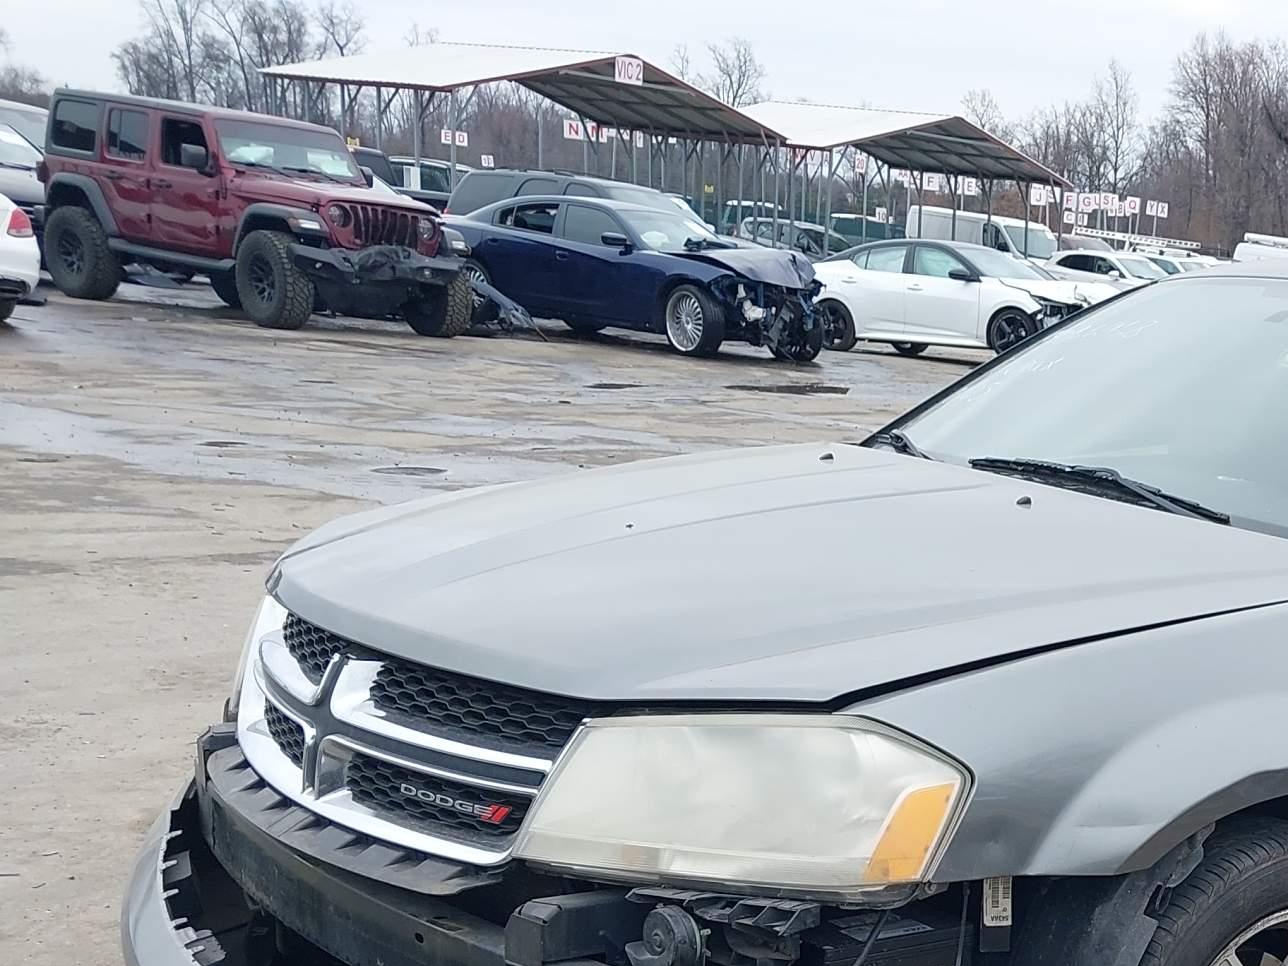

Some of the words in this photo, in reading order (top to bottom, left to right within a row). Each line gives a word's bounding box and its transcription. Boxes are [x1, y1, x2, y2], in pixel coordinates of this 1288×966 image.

[616, 59, 633, 80] VIC
[635, 63, 642, 81] 2
[568, 122, 579, 136] N
[856, 157, 864, 169] 20
[1066, 195, 1072, 205] F
[1082, 196, 1091, 207] G
[401, 783, 493, 818] DODGE
